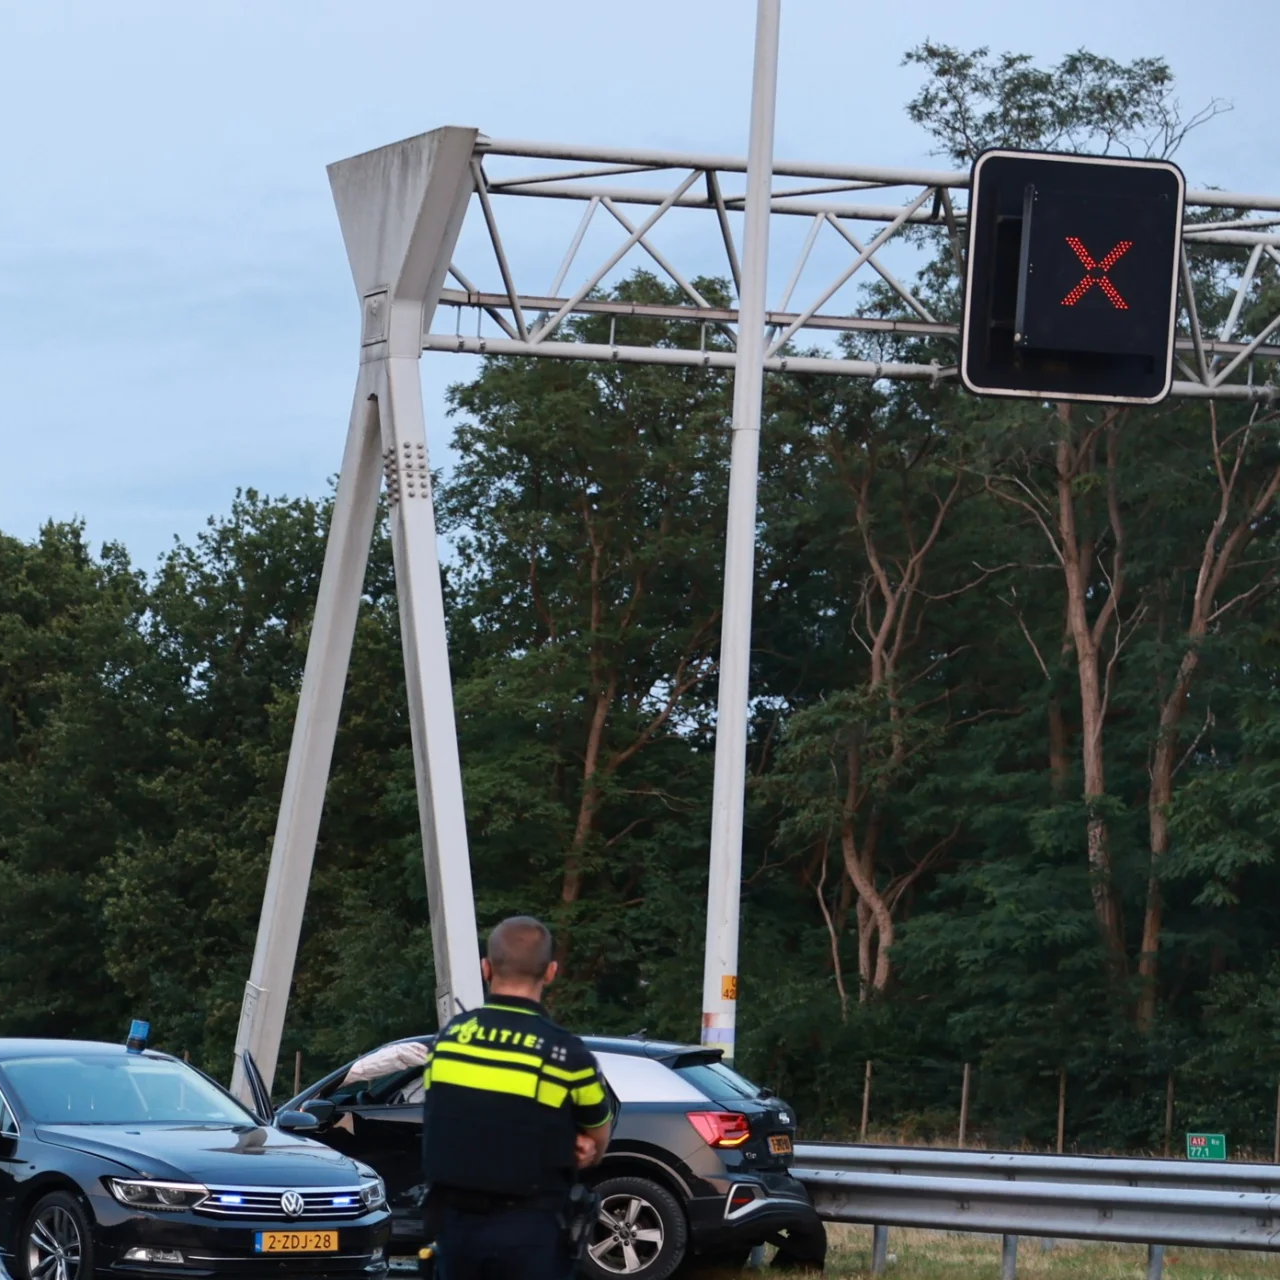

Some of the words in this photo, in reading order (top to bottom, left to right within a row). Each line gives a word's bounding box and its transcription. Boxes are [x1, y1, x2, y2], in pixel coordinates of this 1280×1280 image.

[1192, 1137, 1205, 1145] A12
[1190, 1147, 1209, 1157] 77.1
[268, 1234, 332, 1250] 2-ZDJ-28
